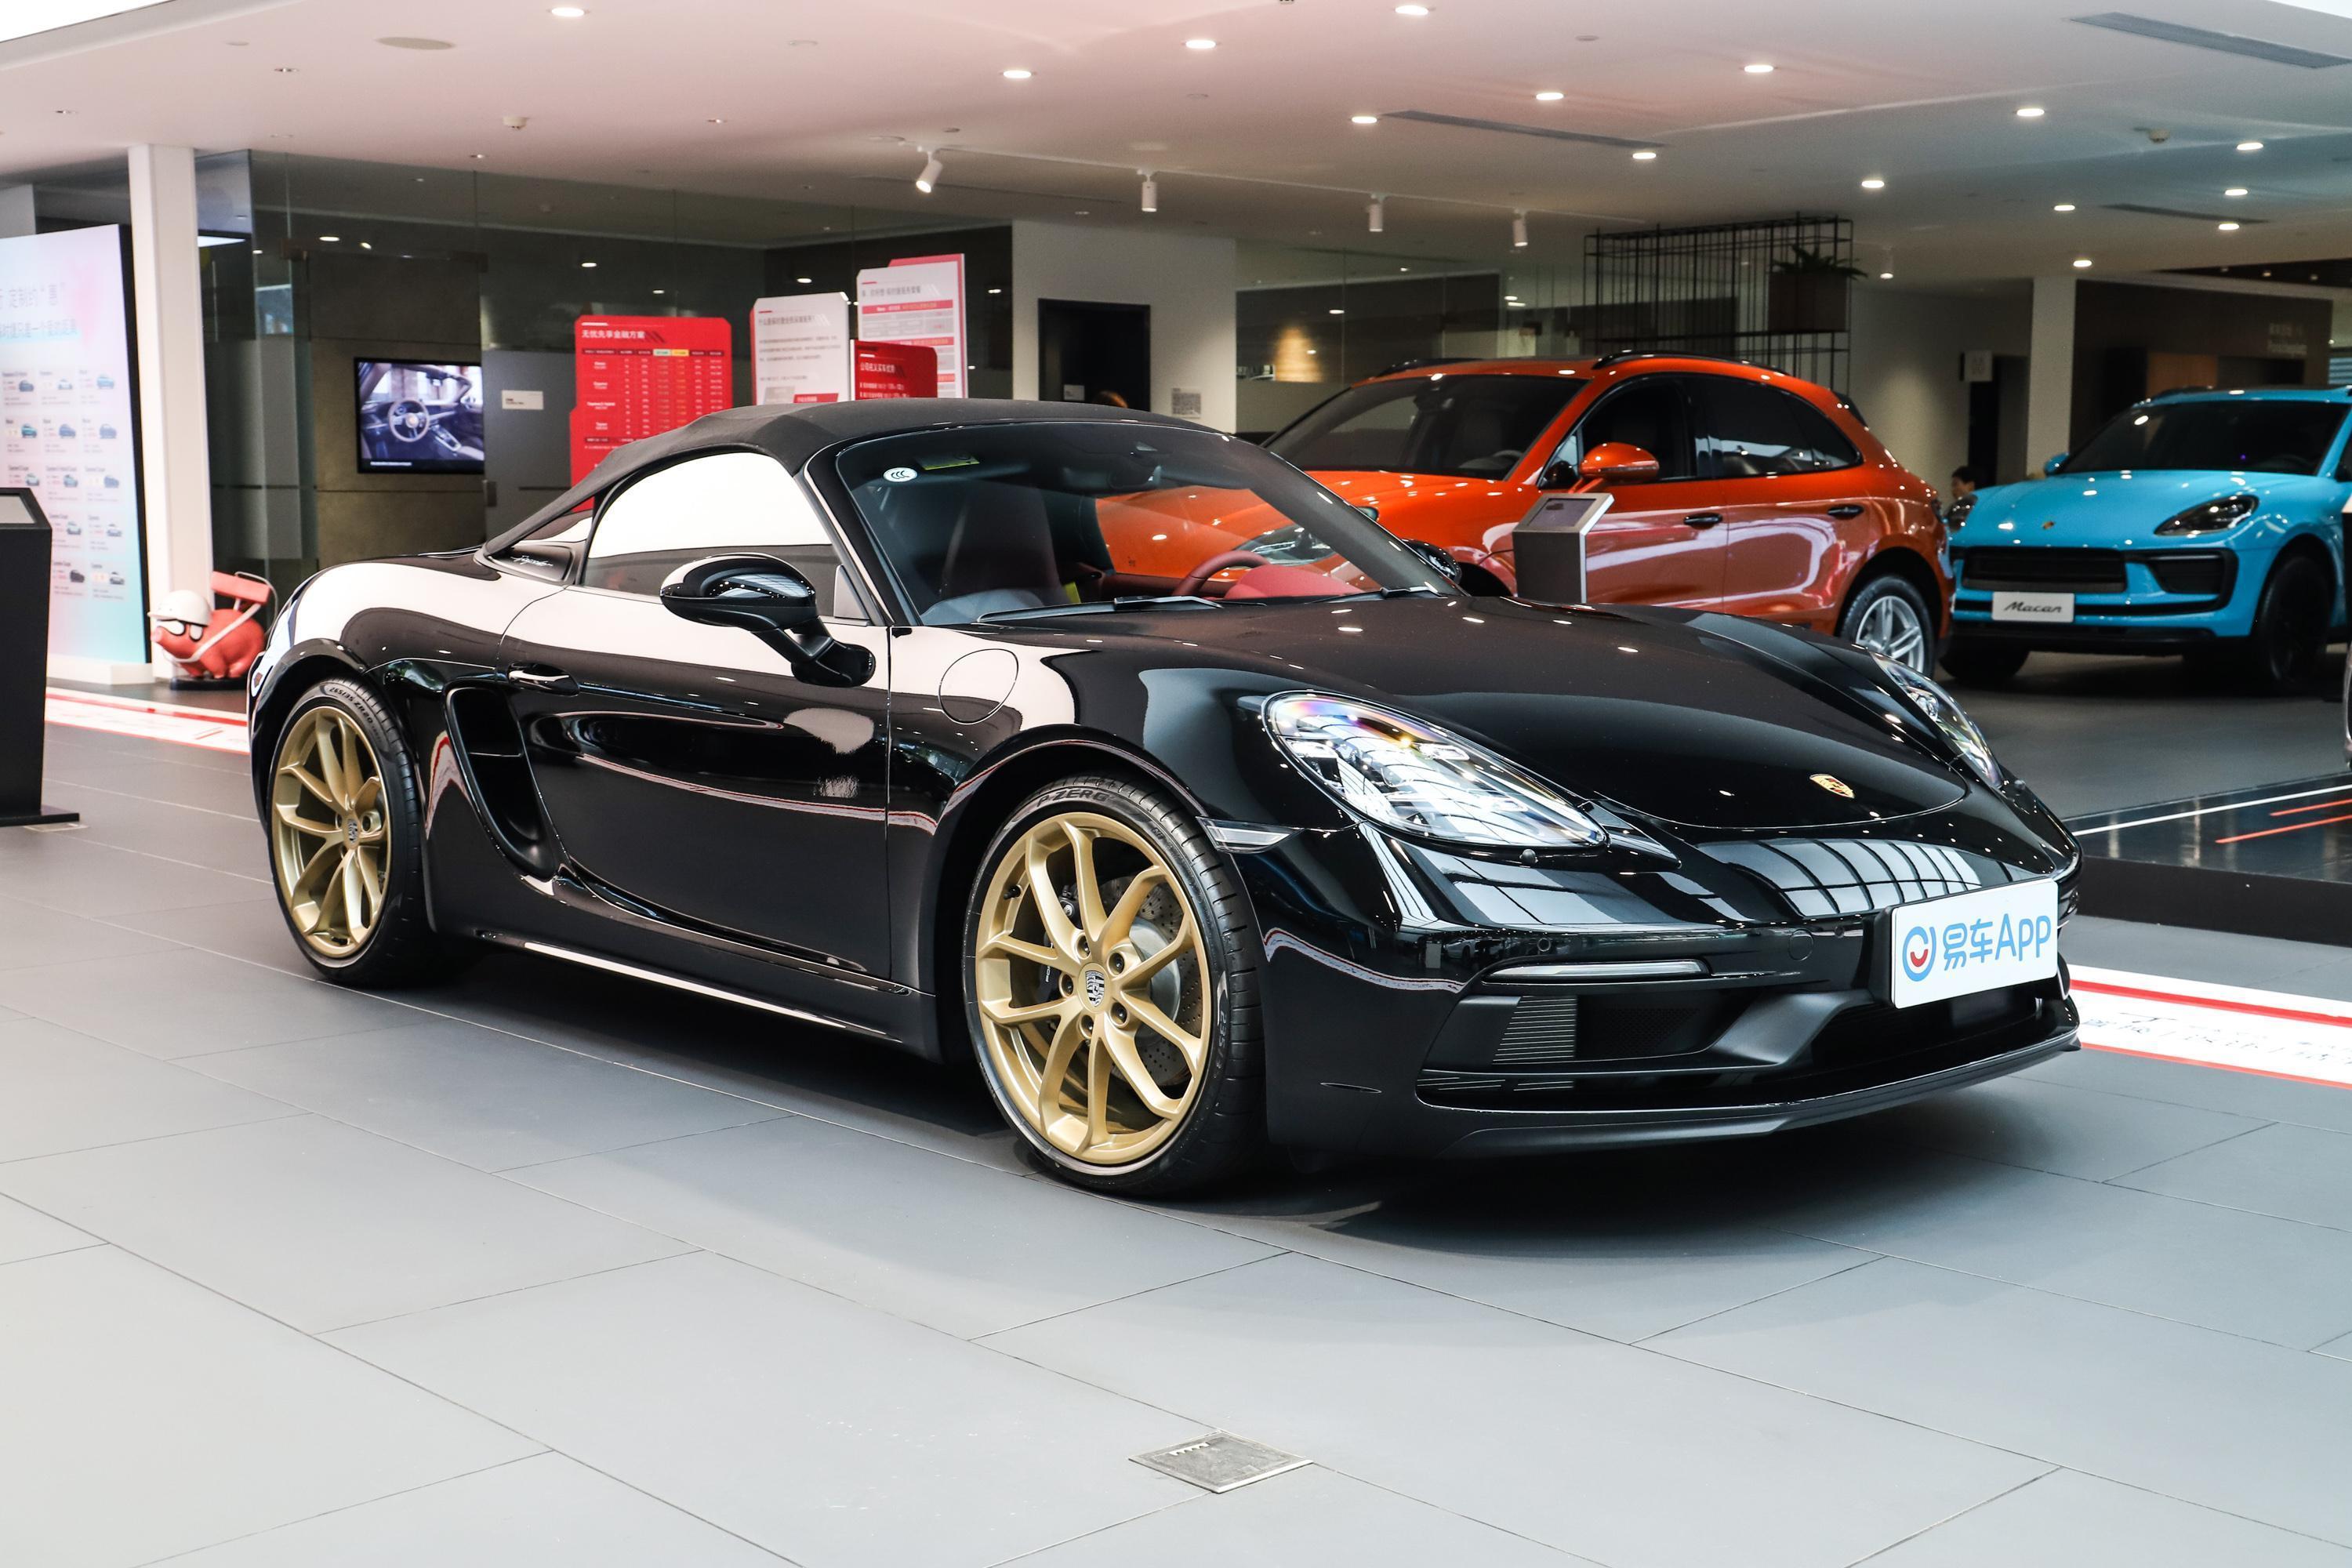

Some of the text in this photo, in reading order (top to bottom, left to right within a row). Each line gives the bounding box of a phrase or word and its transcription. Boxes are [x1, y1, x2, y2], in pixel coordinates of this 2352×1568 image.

[2004, 601, 2062, 613] Macan
[1053, 789, 1109, 801] ZERO
[1942, 913, 2051, 971] 易车App
